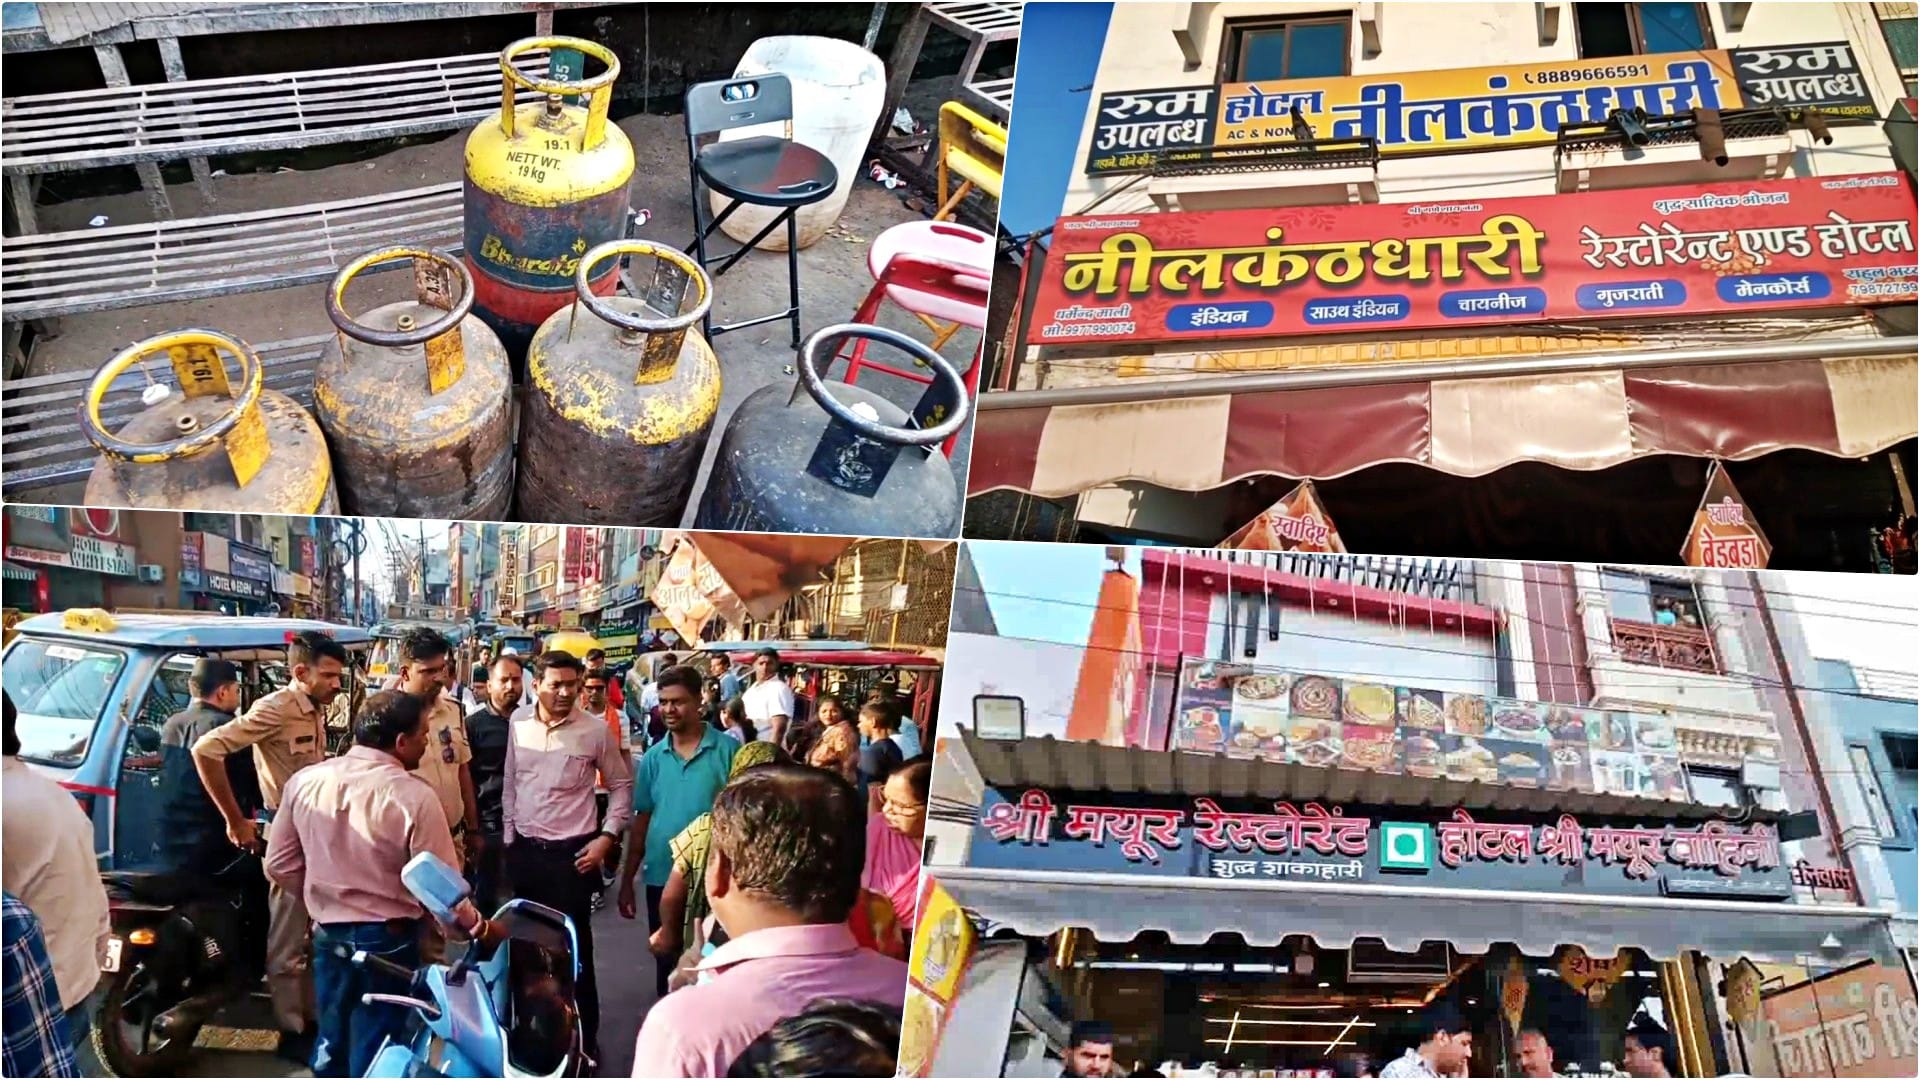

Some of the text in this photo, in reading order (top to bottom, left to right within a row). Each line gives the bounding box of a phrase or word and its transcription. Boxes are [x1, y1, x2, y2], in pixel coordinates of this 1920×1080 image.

[1537, 64, 1650, 85] 8889666591
[1745, 73, 1865, 104] उपलब्ध
[1225, 85, 1324, 125] होटल
[1096, 117, 1208, 151] उपलब्ध
[1227, 125, 1317, 140] AC & NONC
[543, 139, 571, 151] 19.1
[505, 150, 561, 171] NETT WT.
[517, 164, 546, 184] 19 kg
[1580, 210, 1915, 269] रेस्टोरेन्ट एण्ड होटल
[1063, 214, 1546, 295] नीलकंठधारी
[1596, 281, 1664, 308] गुजराती
[1735, 275, 1811, 297] मेनकोर्स
[1095, 302, 1131, 318] माली
[1310, 300, 1399, 320] साउथ इंडियन
[1457, 291, 1528, 312] चायनीज
[1190, 307, 1250, 327] इंडियन
[1271, 513, 1329, 547] स्वादिष्ट
[209, 575, 231, 592] HOTEL
[980, 789, 1371, 862] श्री मयूर रेस्टोरेंट
[1438, 807, 1780, 881] होटल श्री मयूर वाहिनी
[1211, 858, 1364, 880] शुद्ध शाकाहारी
